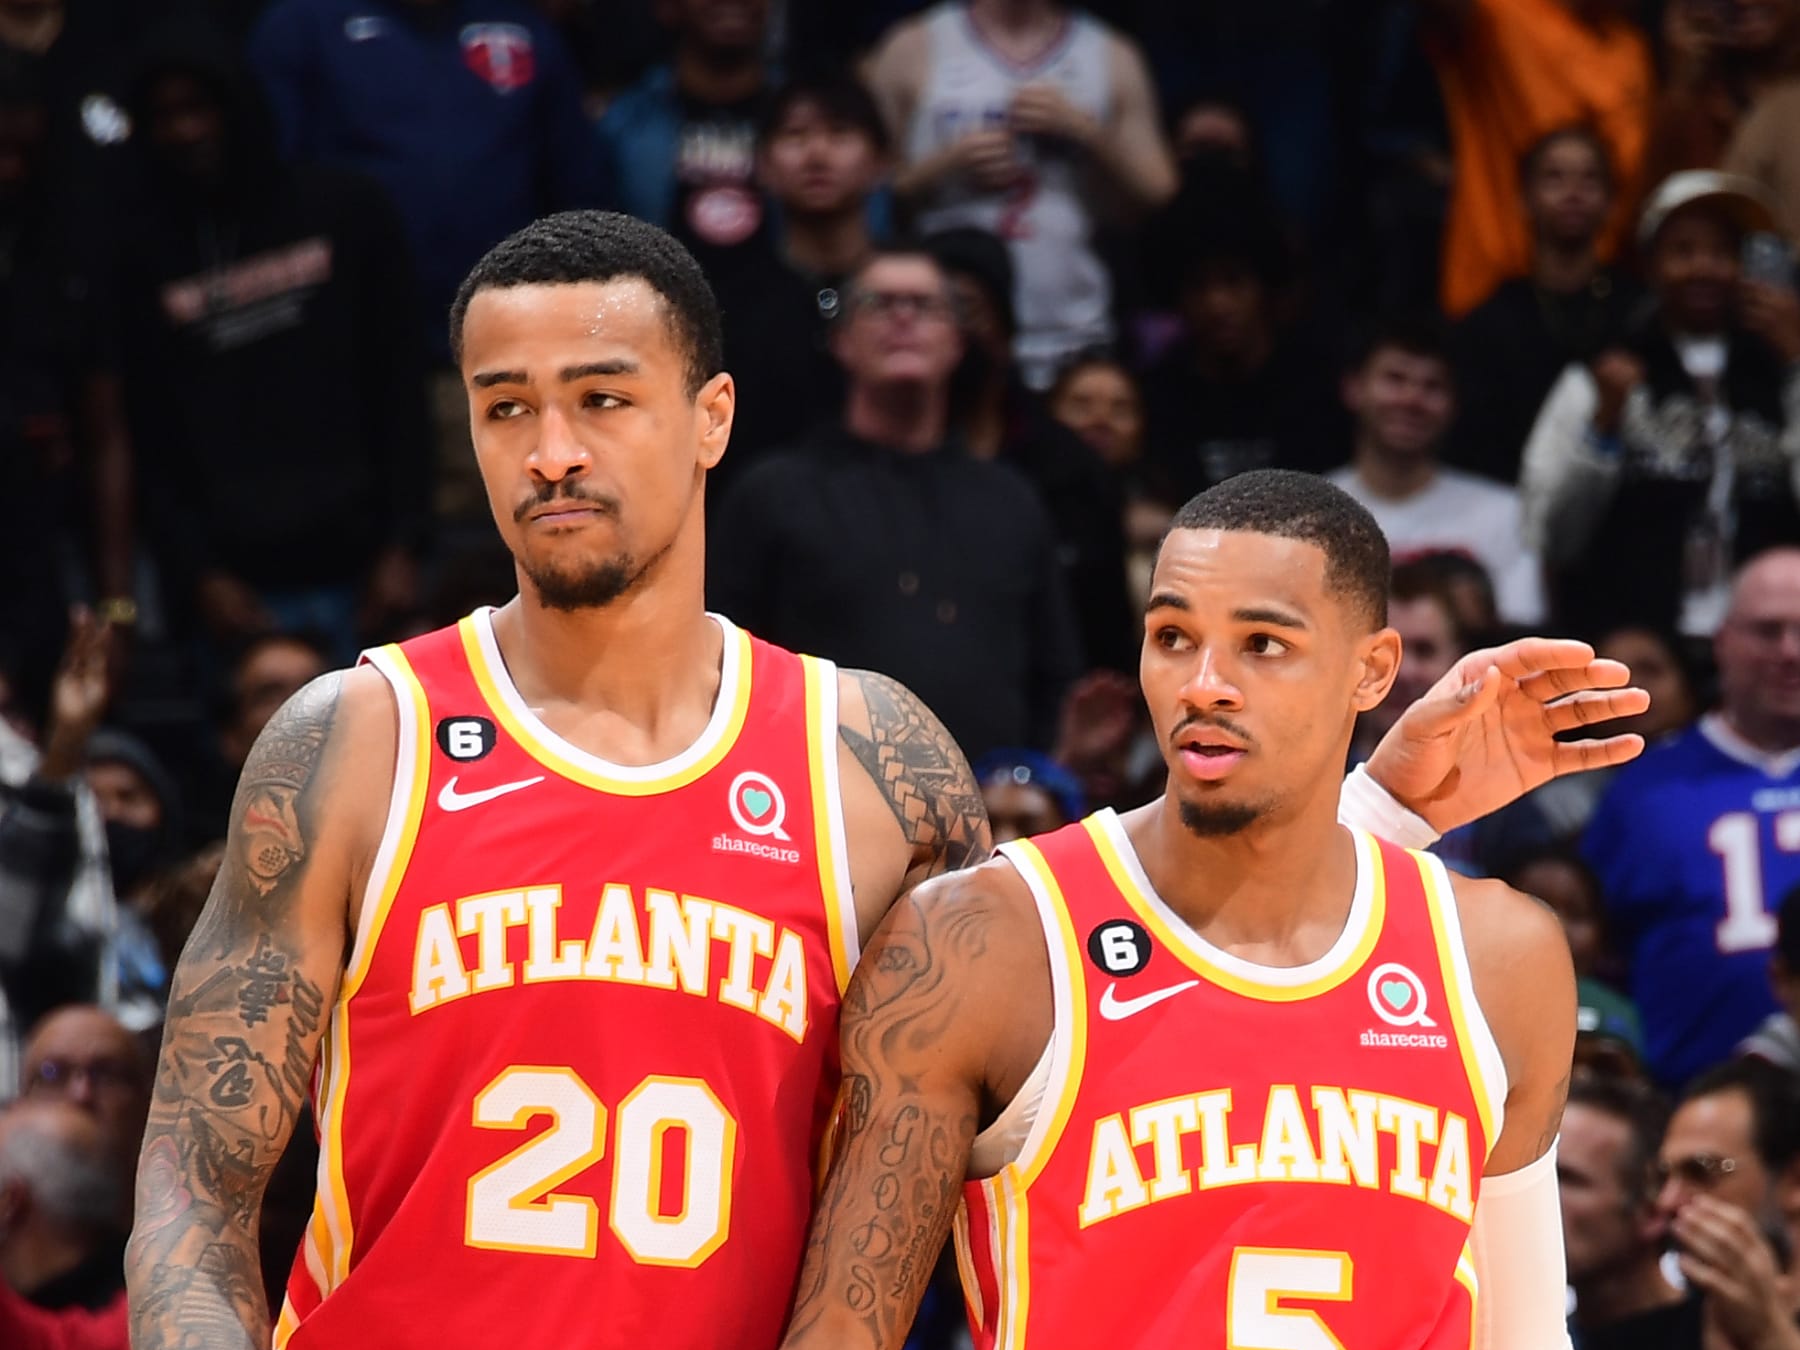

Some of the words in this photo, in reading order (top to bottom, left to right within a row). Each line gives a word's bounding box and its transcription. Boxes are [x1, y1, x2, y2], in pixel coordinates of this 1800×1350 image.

[449, 721, 483, 758] 6
[712, 832, 801, 864] sharecare
[408, 882, 809, 1044] ATLANTA
[1100, 925, 1139, 971] 6
[1359, 1028, 1449, 1049] sharecare
[465, 1065, 738, 1268] 20
[1079, 1084, 1475, 1229] ATLANTA
